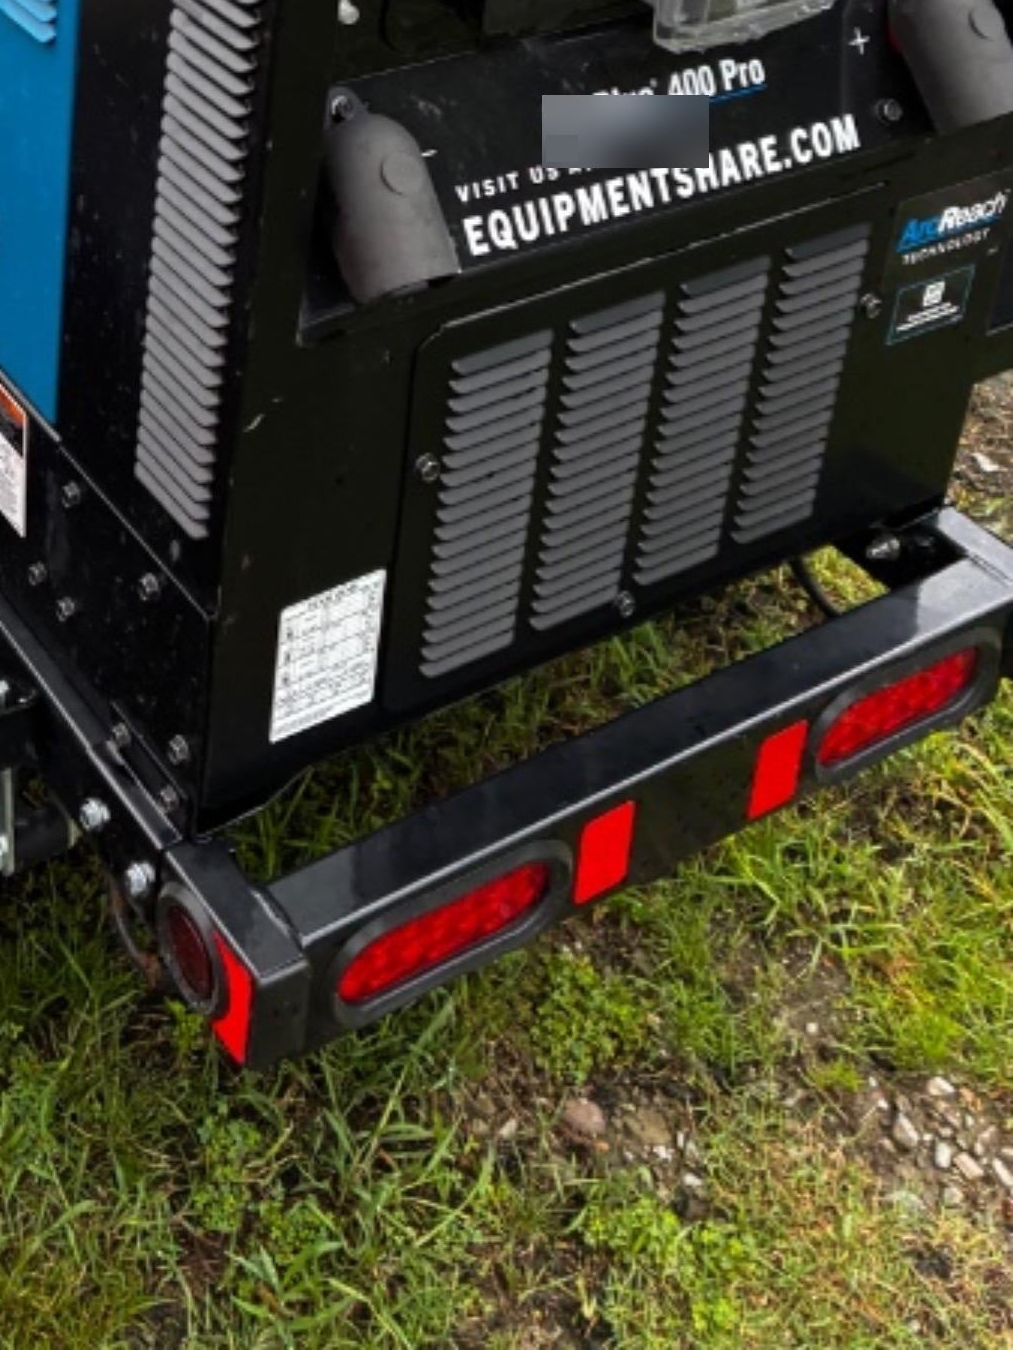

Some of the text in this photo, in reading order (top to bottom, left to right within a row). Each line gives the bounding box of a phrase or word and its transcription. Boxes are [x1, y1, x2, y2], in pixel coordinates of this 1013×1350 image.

[667, 58, 766, 96] 400 Pro
[454, 170, 519, 202] VISIT
[462, 113, 861, 257] EQUIPMENTSHARE.COM
